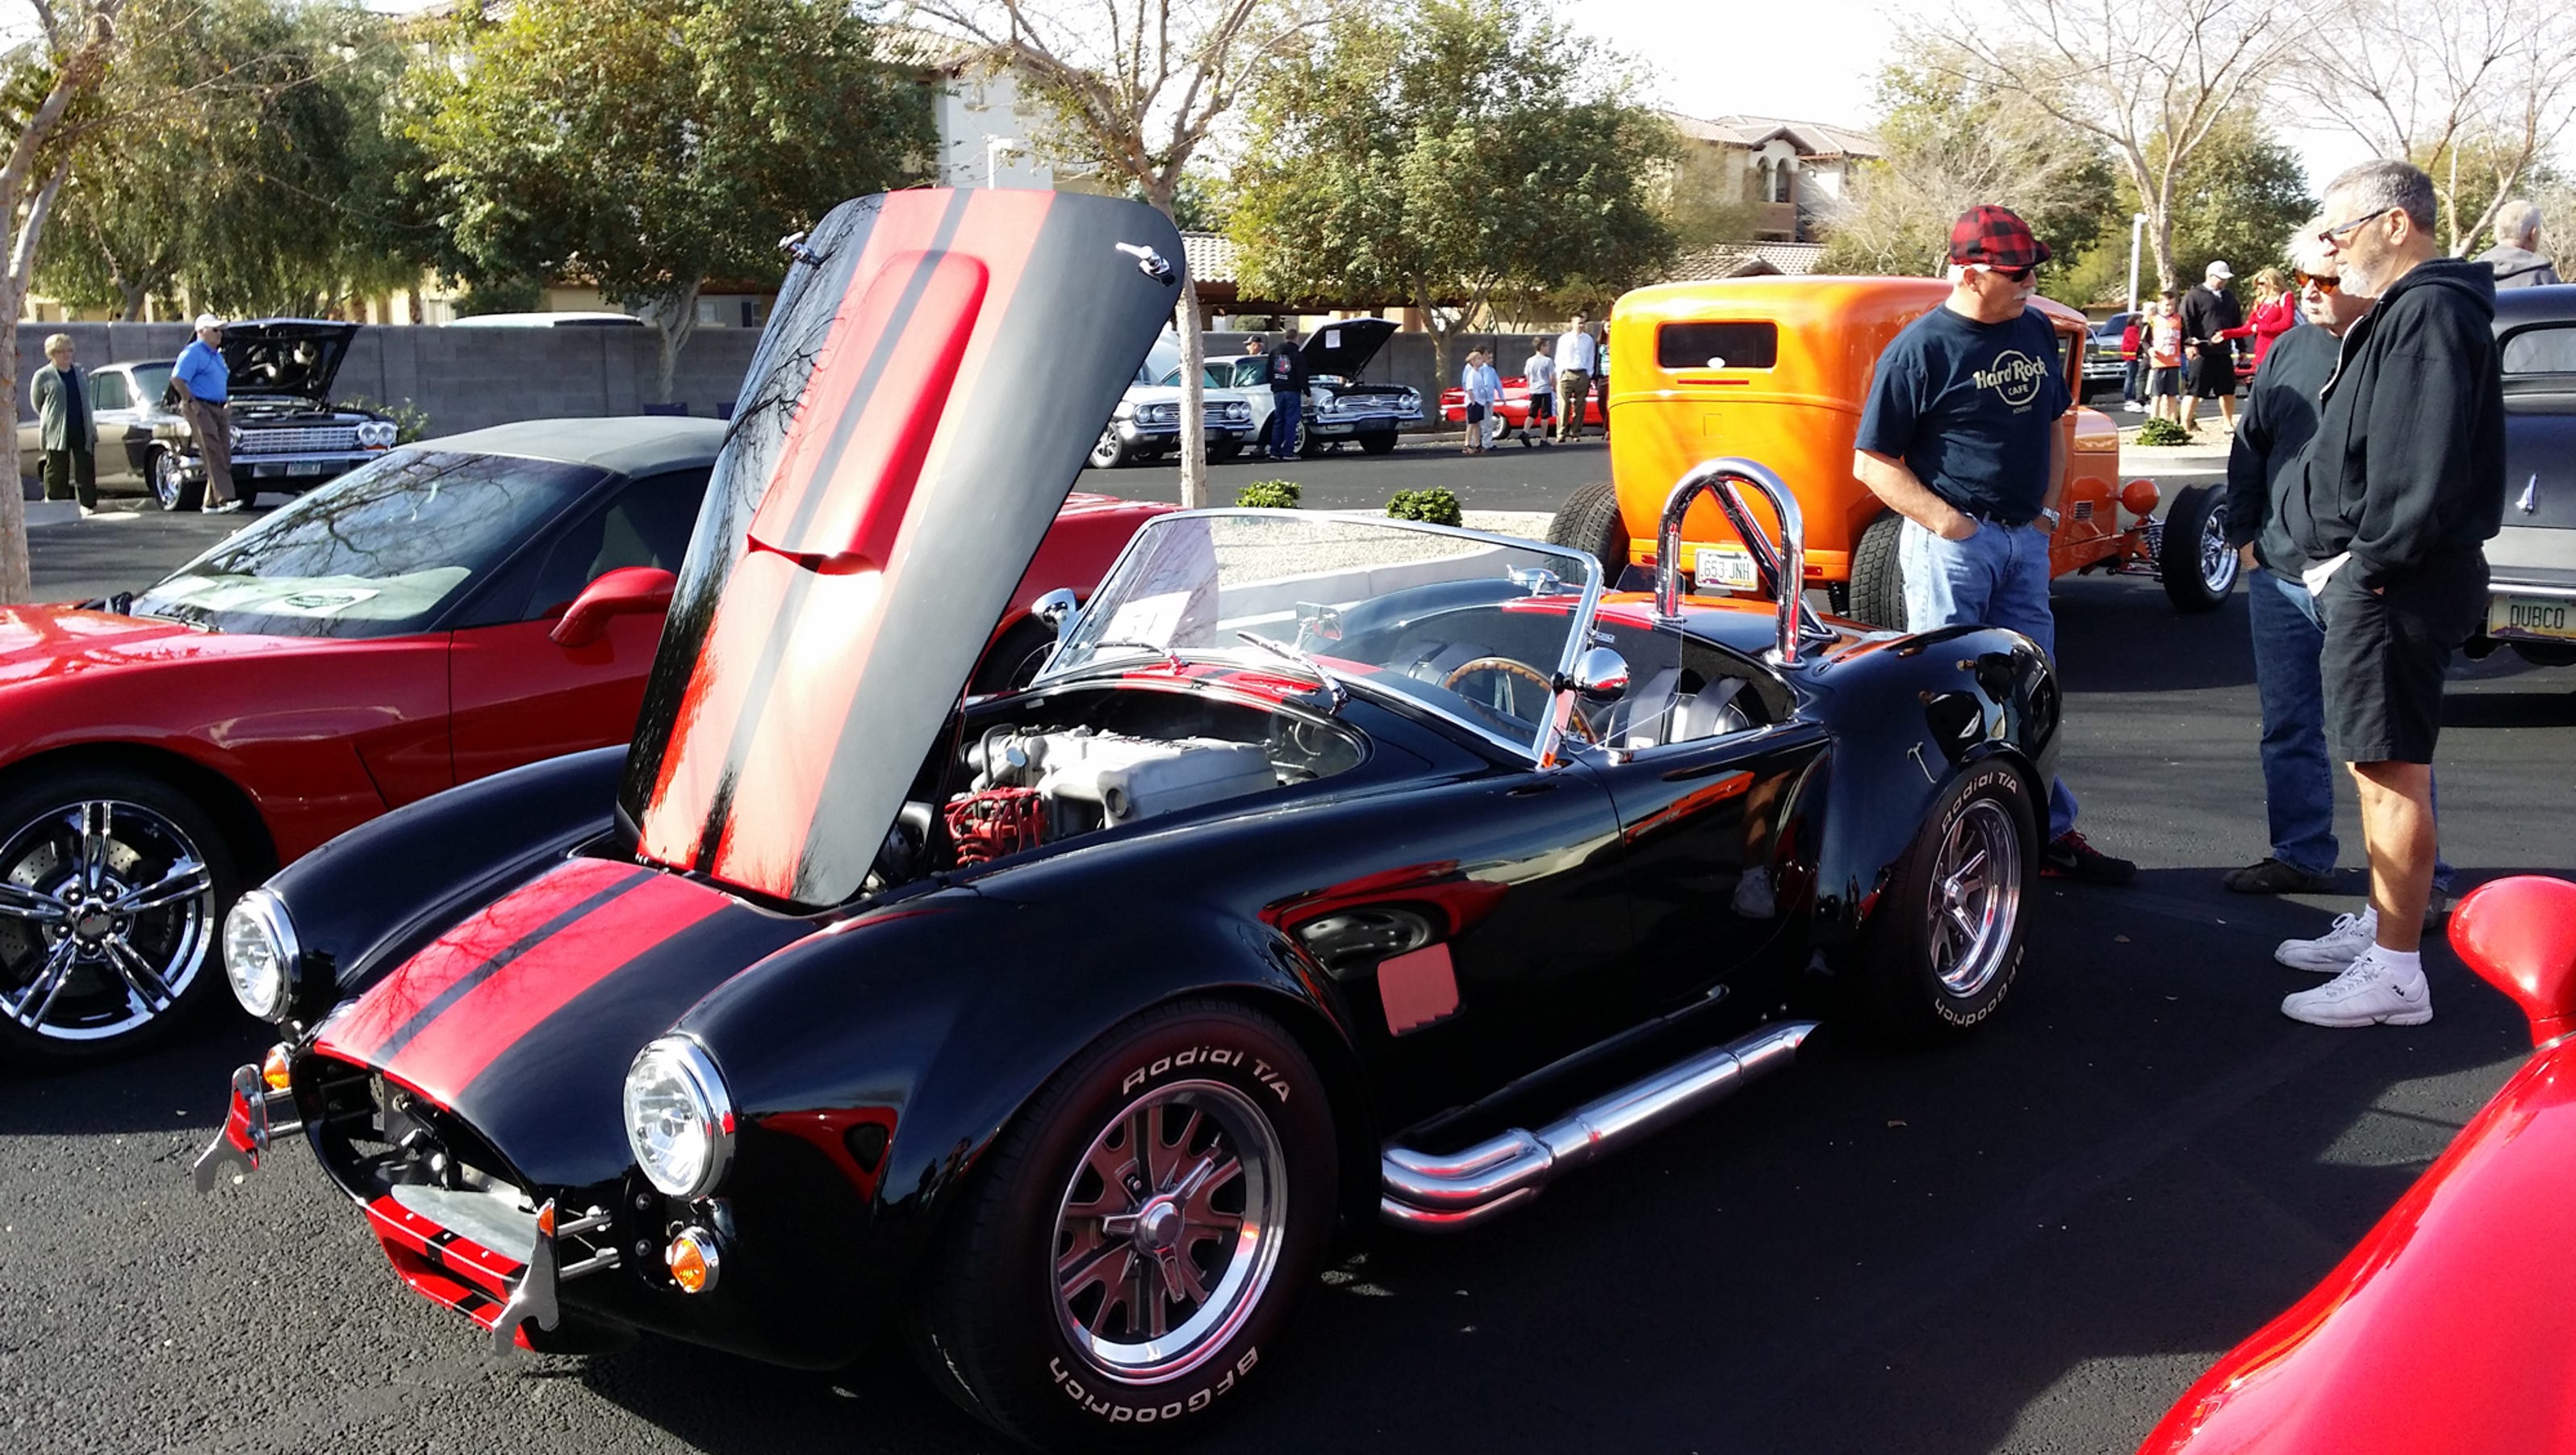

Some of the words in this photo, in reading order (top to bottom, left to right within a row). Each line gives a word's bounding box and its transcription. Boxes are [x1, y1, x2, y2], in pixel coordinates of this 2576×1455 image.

[1972, 362, 2012, 390] Hard
[2012, 355, 2049, 383] Rock
[2008, 383, 2029, 396] CAFE
[2510, 604, 2566, 629] DUBCO
[1941, 771, 1994, 835] Radial
[1997, 771, 2018, 795] T/A
[1123, 1045, 1245, 1096] Radial
[1252, 1058, 1291, 1103] T/A
